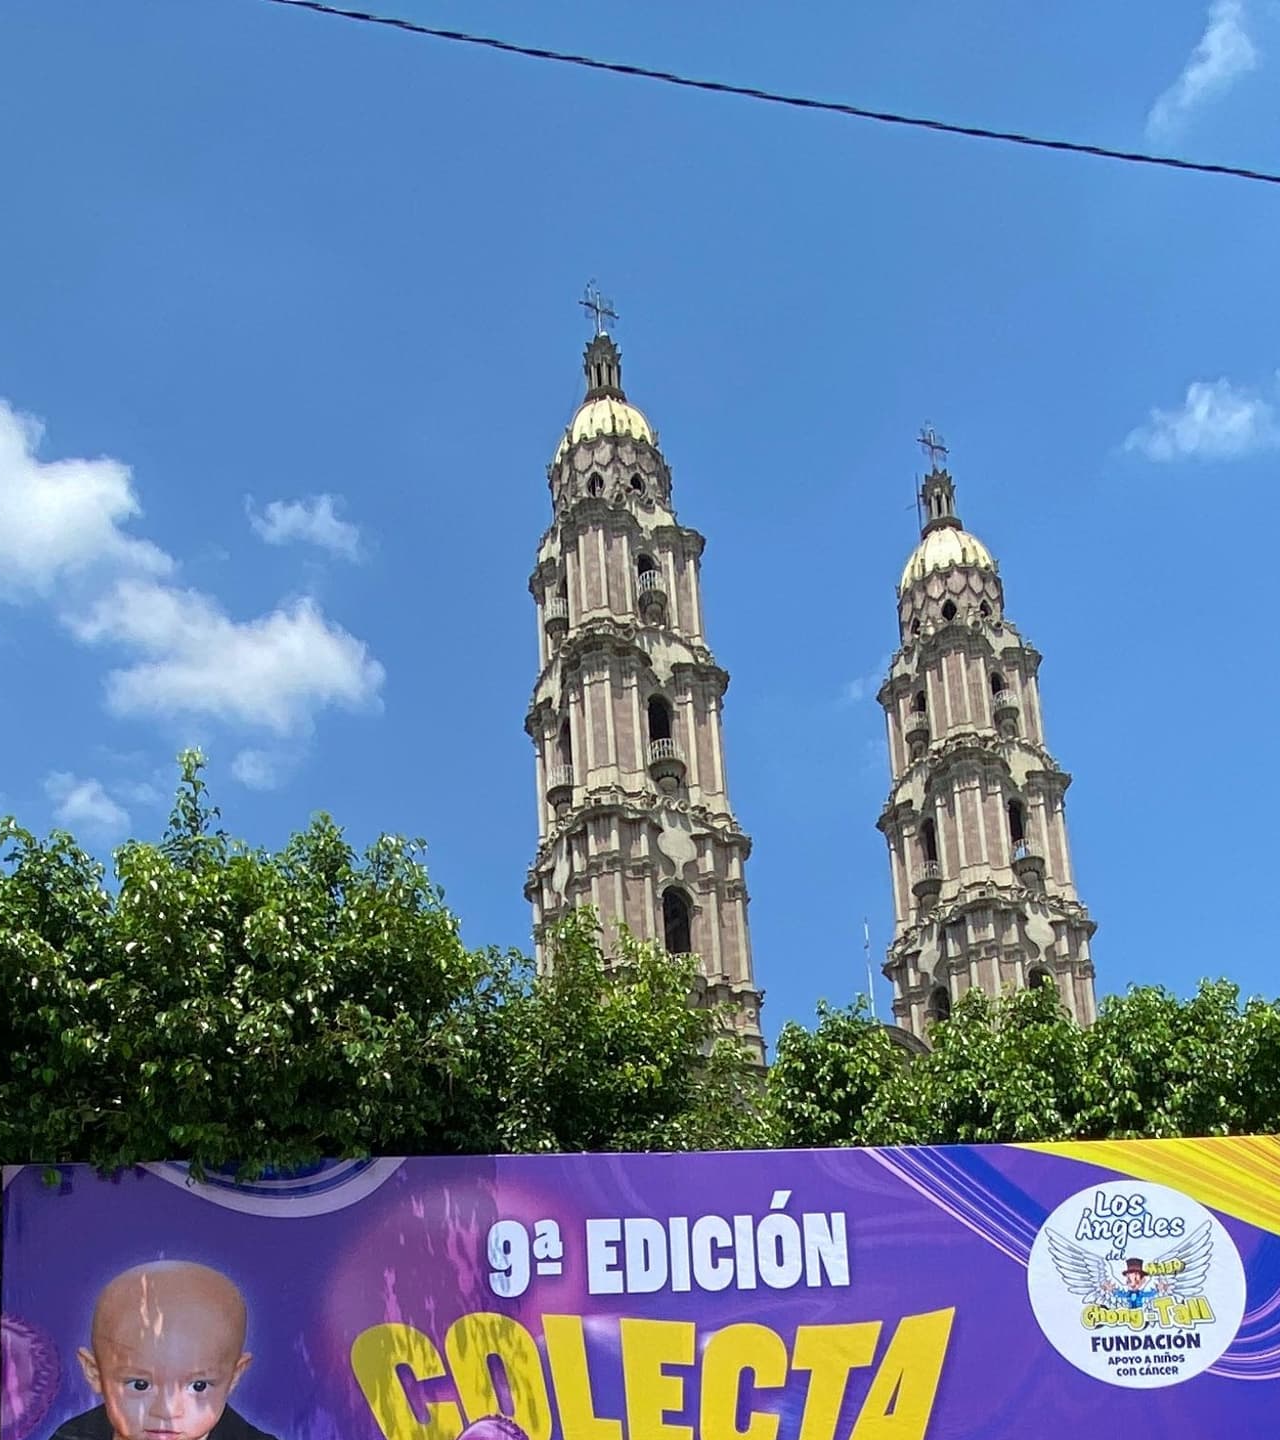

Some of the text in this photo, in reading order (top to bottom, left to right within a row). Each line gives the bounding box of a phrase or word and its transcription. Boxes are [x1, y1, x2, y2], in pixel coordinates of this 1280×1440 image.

[1094, 1191, 1146, 1217] Los
[1075, 1208, 1185, 1250] Ángeles
[585, 1189, 851, 1295] EDICIÓN
[1105, 1248, 1127, 1262] del
[1091, 1329, 1201, 1353] FUNDACIÓN
[1144, 1355, 1152, 1365] A
